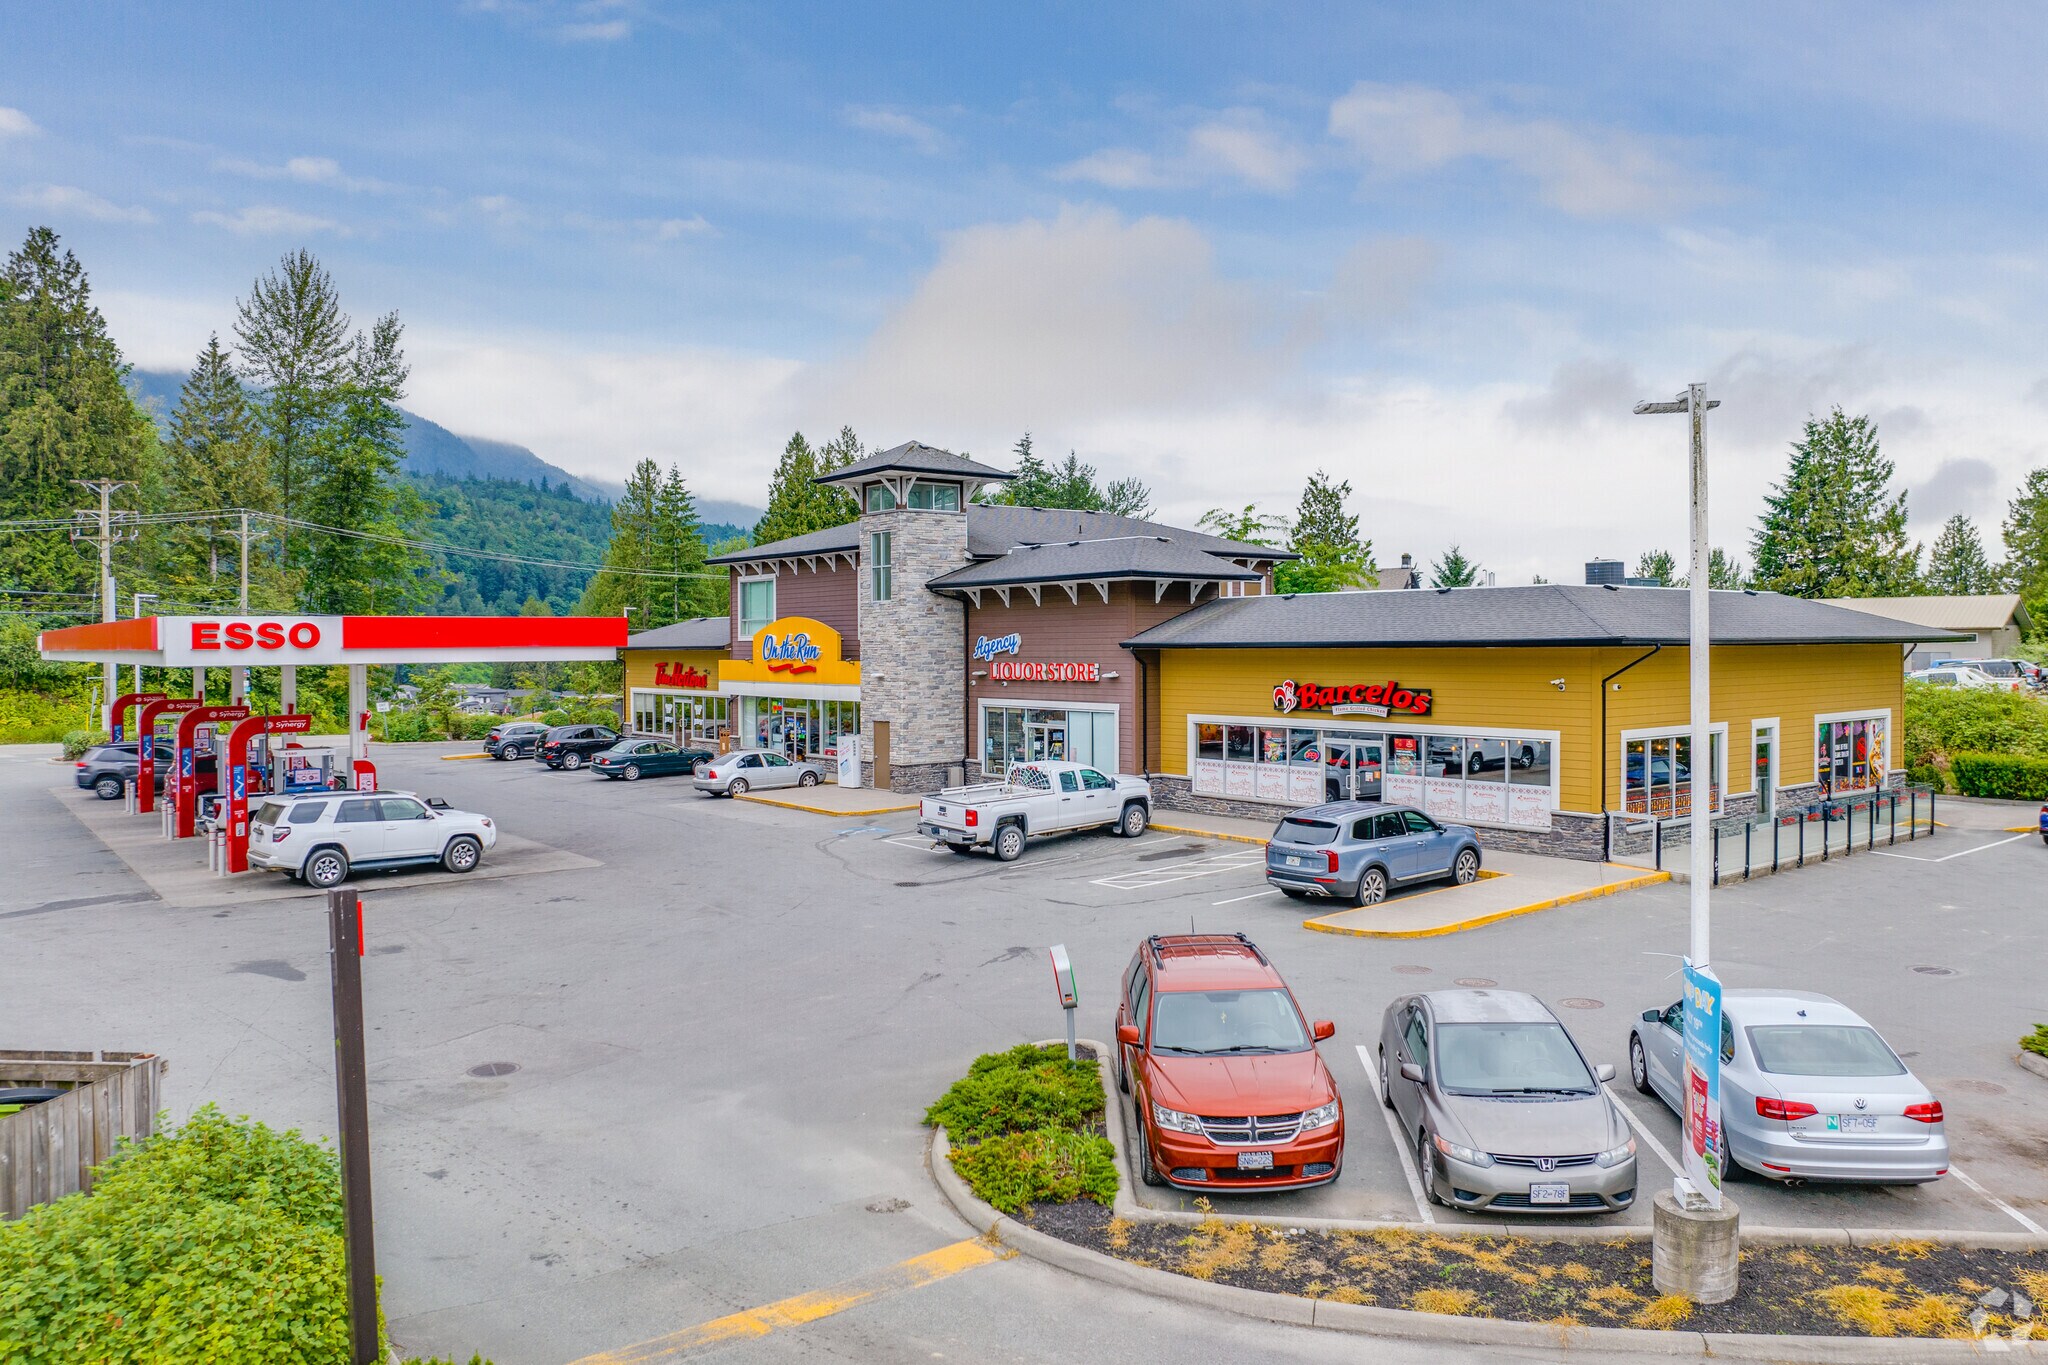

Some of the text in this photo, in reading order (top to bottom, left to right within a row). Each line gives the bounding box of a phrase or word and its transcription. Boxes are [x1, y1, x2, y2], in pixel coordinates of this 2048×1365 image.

[191, 622, 321, 649] ESSO
[762, 633, 821, 663] On the Run
[973, 633, 1021, 661] Agency
[655, 662, 671, 686] Tim
[990, 662, 1098, 681] LIQUOR STORE
[1297, 680, 1430, 715] Barcelos
[1366, 706, 1386, 714] Chicken
[275, 721, 307, 729] Synergy
